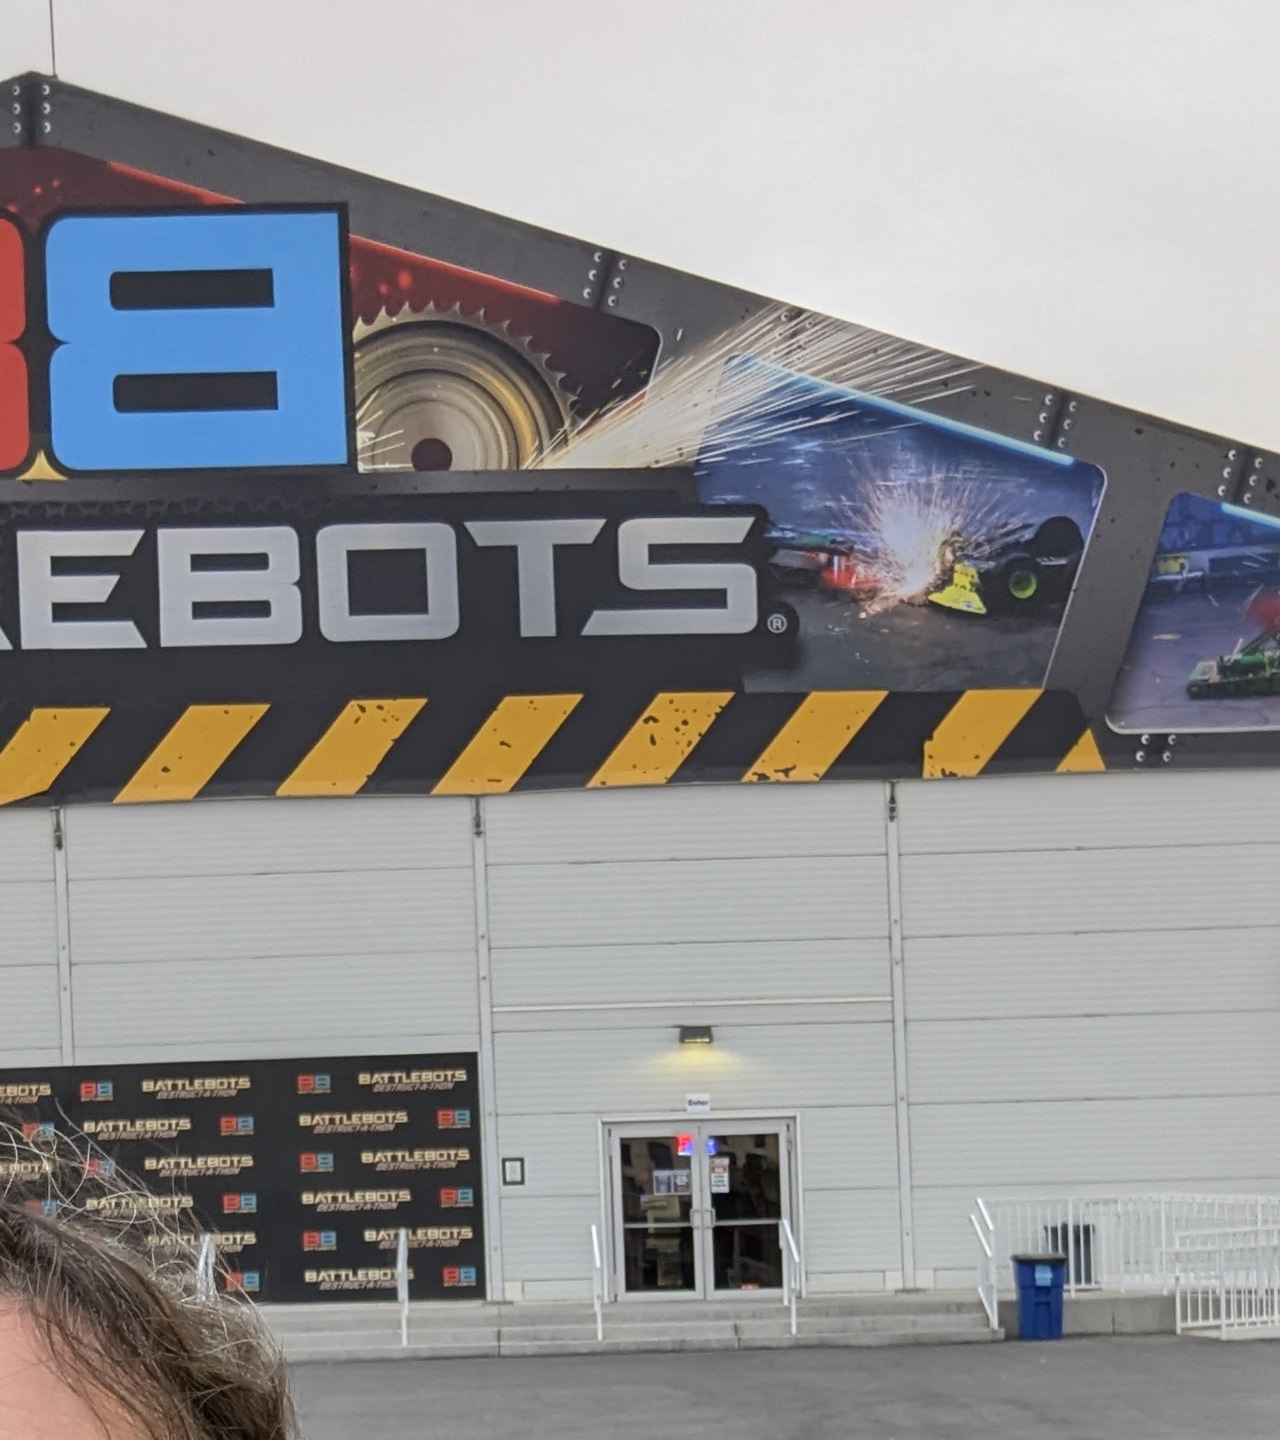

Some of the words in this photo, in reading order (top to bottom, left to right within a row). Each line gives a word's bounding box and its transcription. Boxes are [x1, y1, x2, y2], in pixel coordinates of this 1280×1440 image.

[142, 1077, 251, 1092] BATTLEBOTS
[358, 1070, 467, 1085] BATTLEBOTS
[83, 1118, 192, 1133] BATTLEBOTS
[299, 1111, 408, 1126] BATTLEBOTS
[144, 1154, 254, 1170] BATTLEBOTS
[361, 1149, 471, 1164] BATTLEBOTS
[302, 1190, 411, 1205] BATTLEBOTS
[364, 1227, 473, 1242] BATLEBOTS
